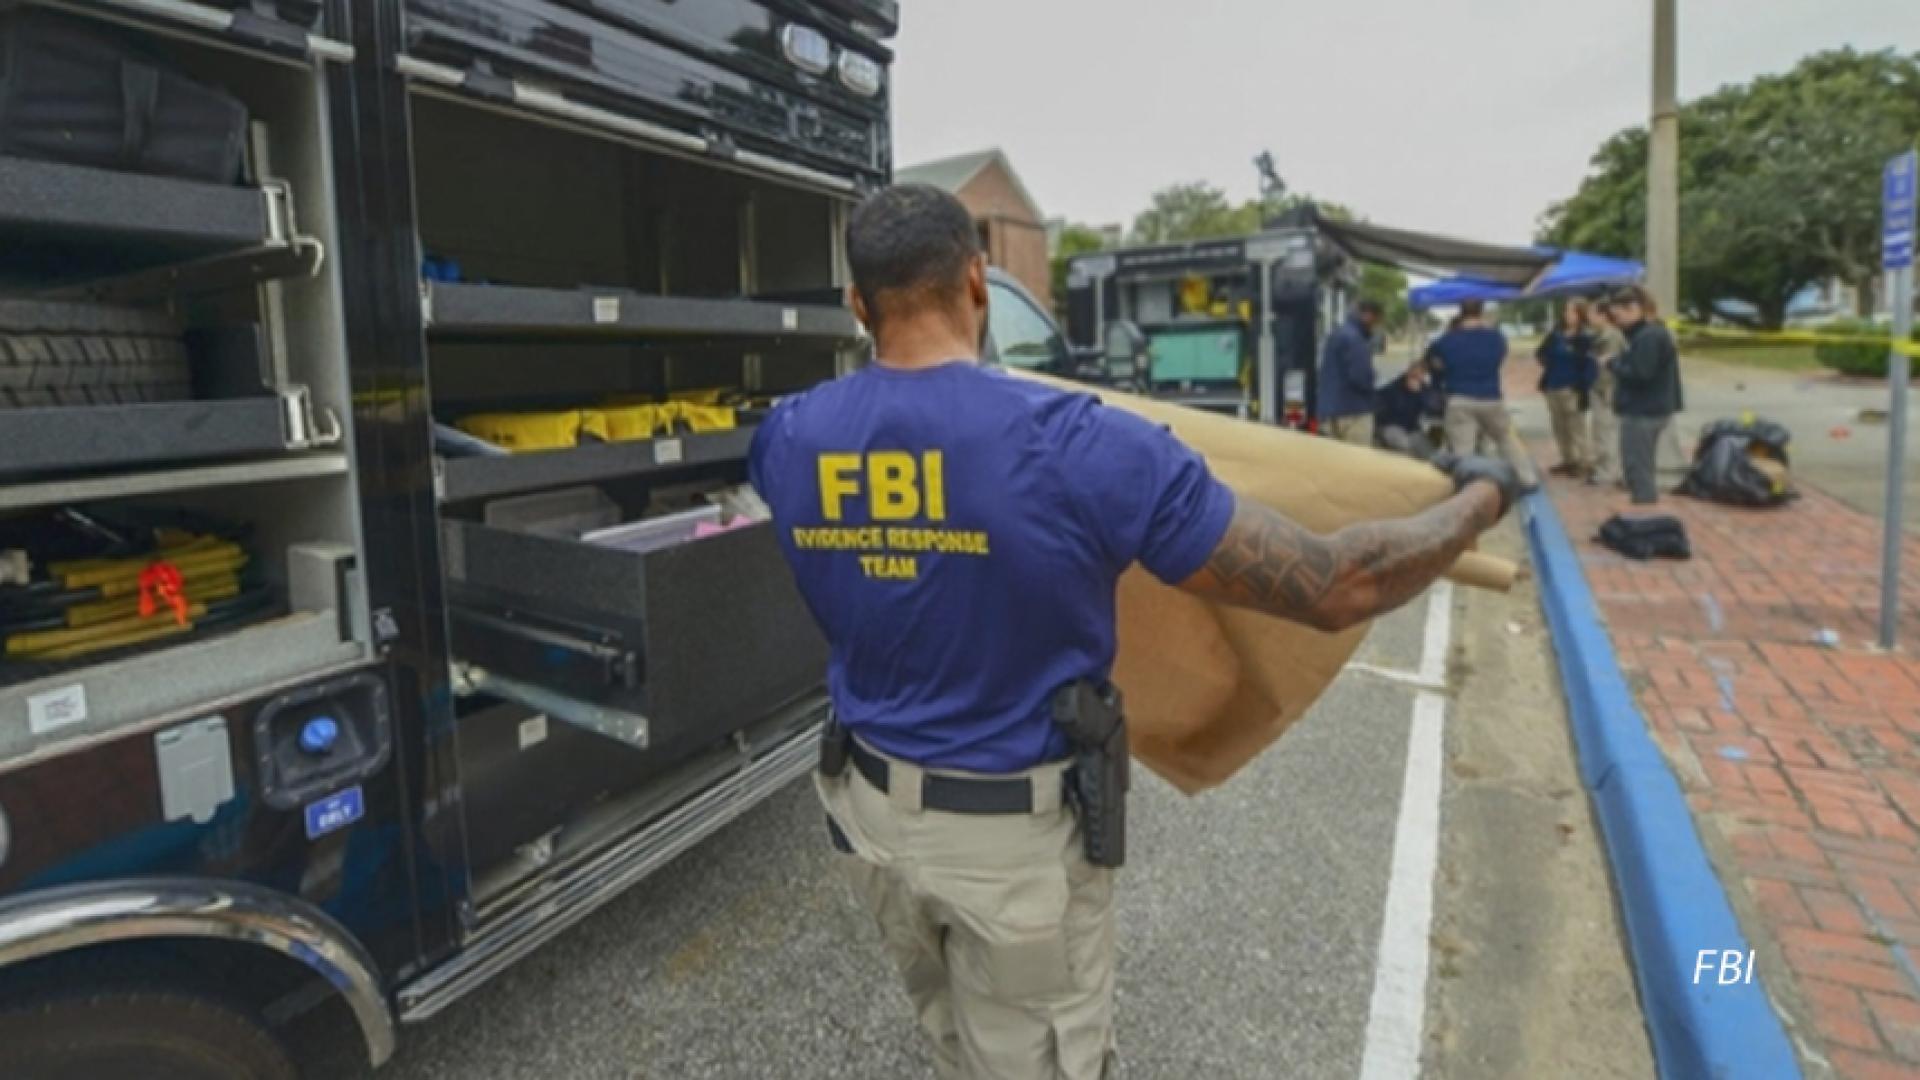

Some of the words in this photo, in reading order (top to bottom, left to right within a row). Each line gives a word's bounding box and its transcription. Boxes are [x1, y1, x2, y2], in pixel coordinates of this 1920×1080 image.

[817, 449, 946, 521] FBI
[792, 526, 883, 549] EVIDENCE
[886, 527, 989, 555] RESPONSE
[859, 556, 917, 578] TEAM
